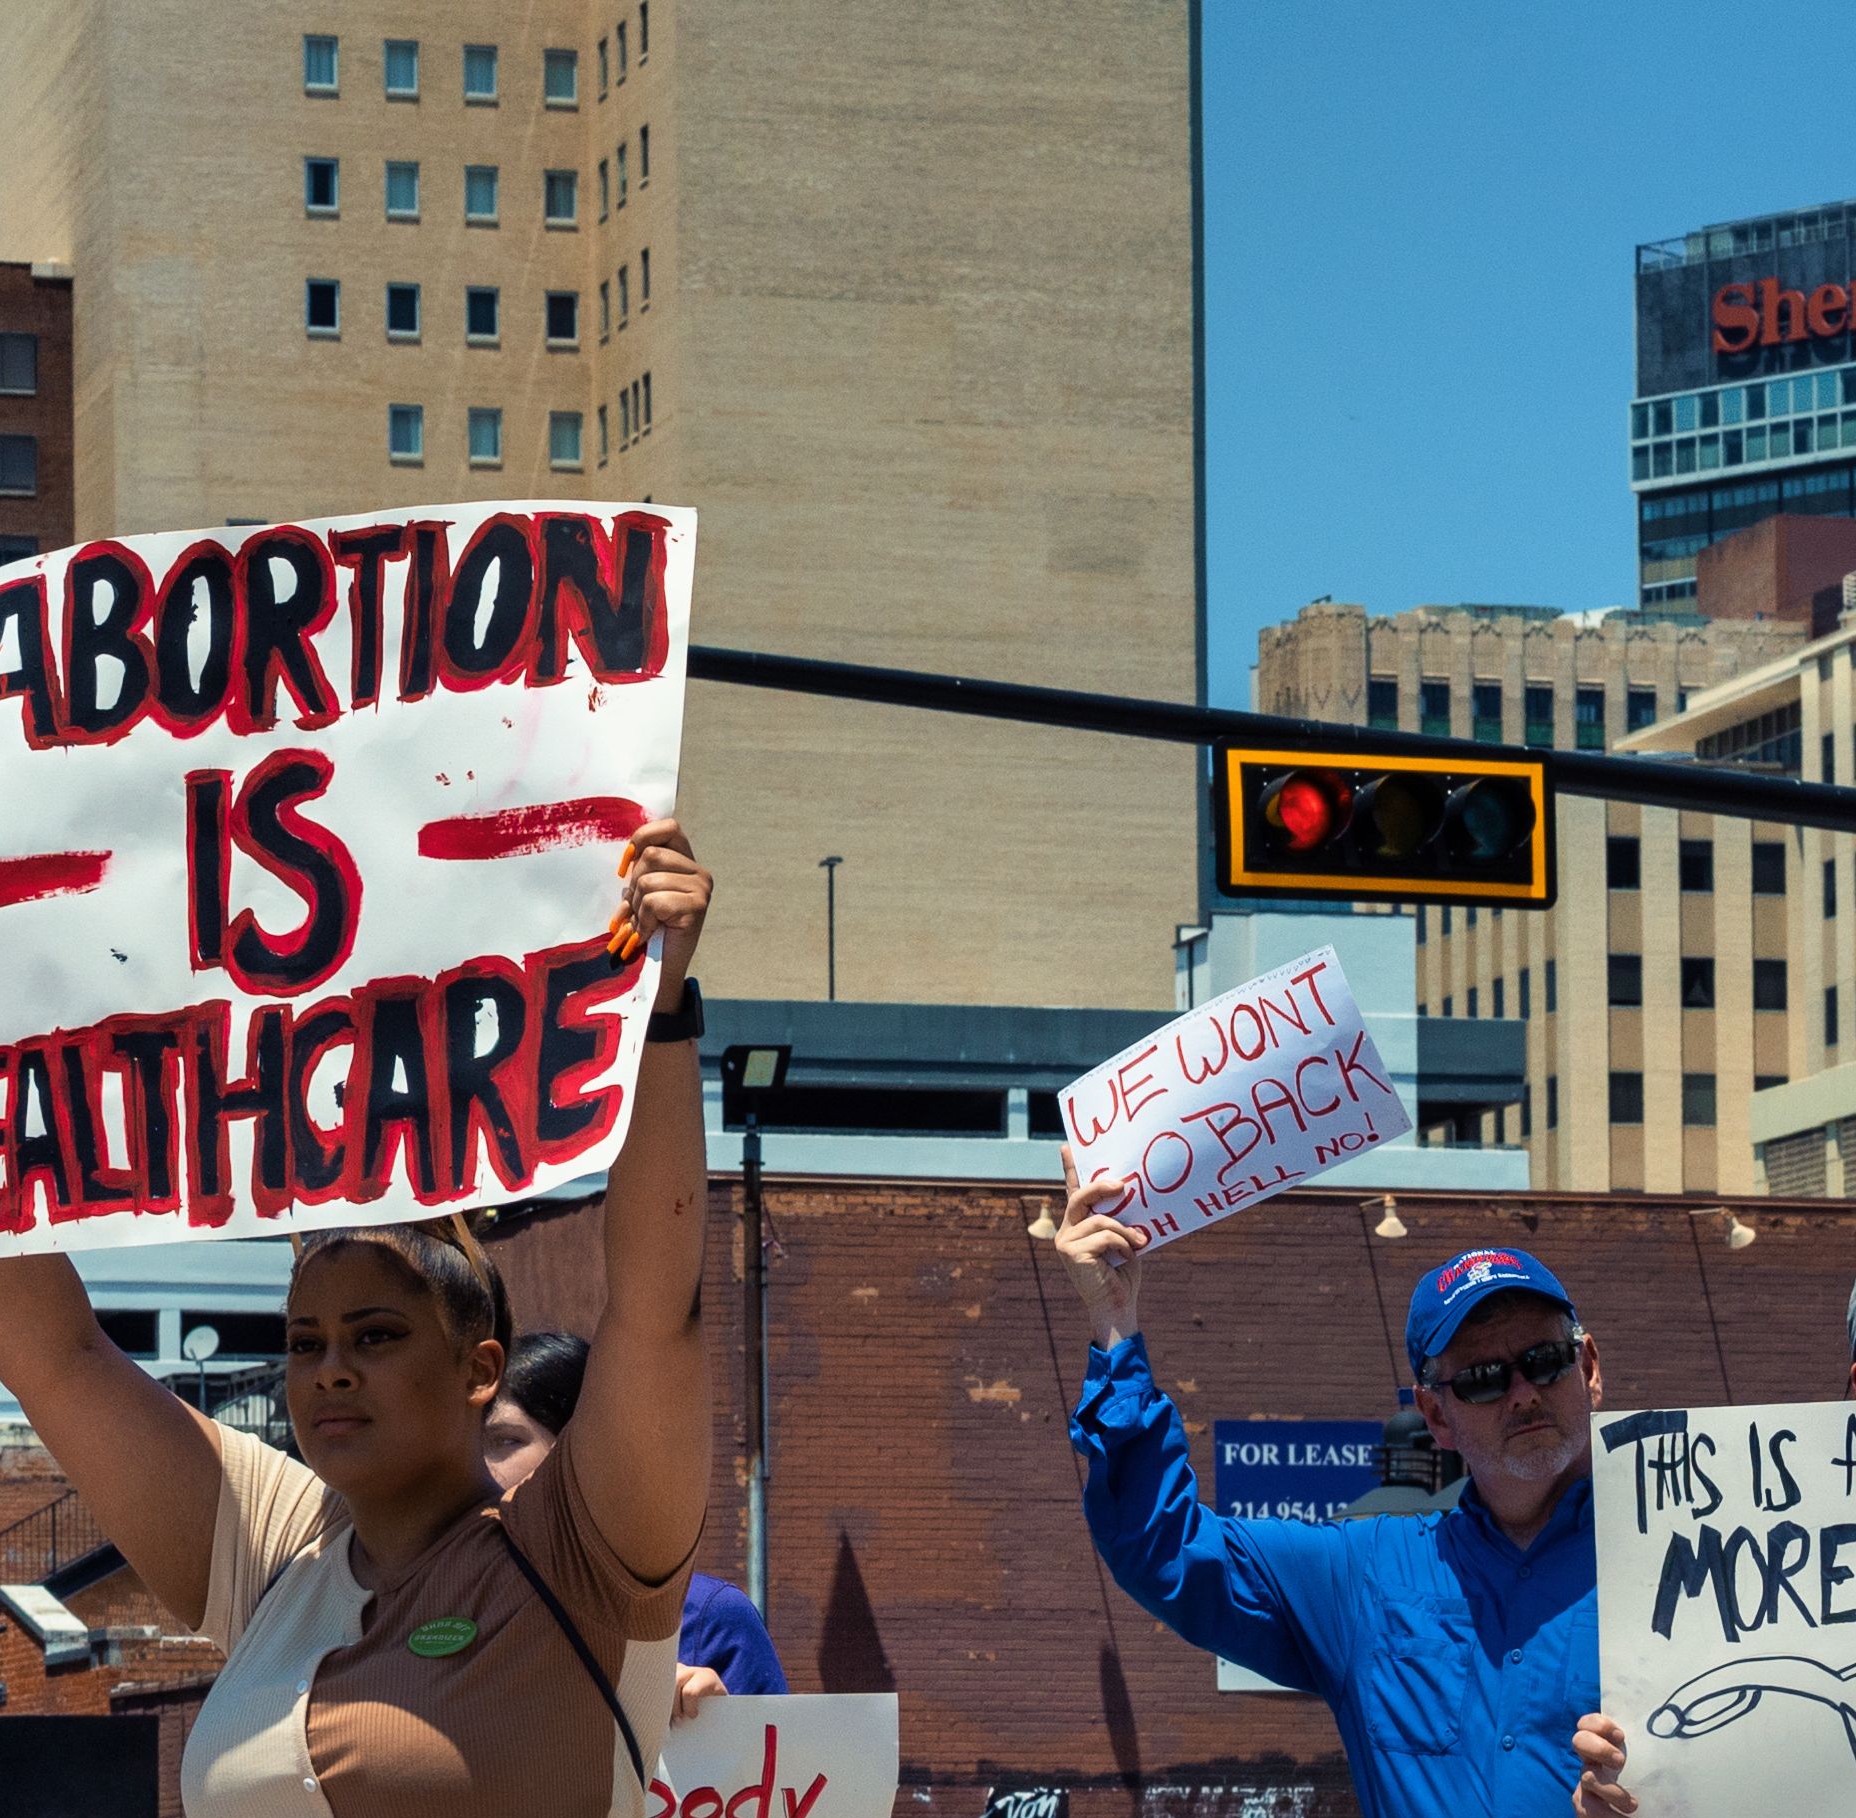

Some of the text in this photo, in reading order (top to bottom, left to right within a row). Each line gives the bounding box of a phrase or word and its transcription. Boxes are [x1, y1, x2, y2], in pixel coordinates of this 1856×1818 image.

[184, 747, 364, 998] IS
[1068, 962, 1335, 1147] WE WONT
[1090, 1031, 1392, 1218] GO BACK
[1193, 1166, 1306, 1217] HELL
[1315, 1112, 1380, 1164] NO!
[1224, 1443, 1373, 1466] FOR LEASE
[1600, 1410, 1723, 1534] THIS
[1747, 1421, 1802, 1513] IS
